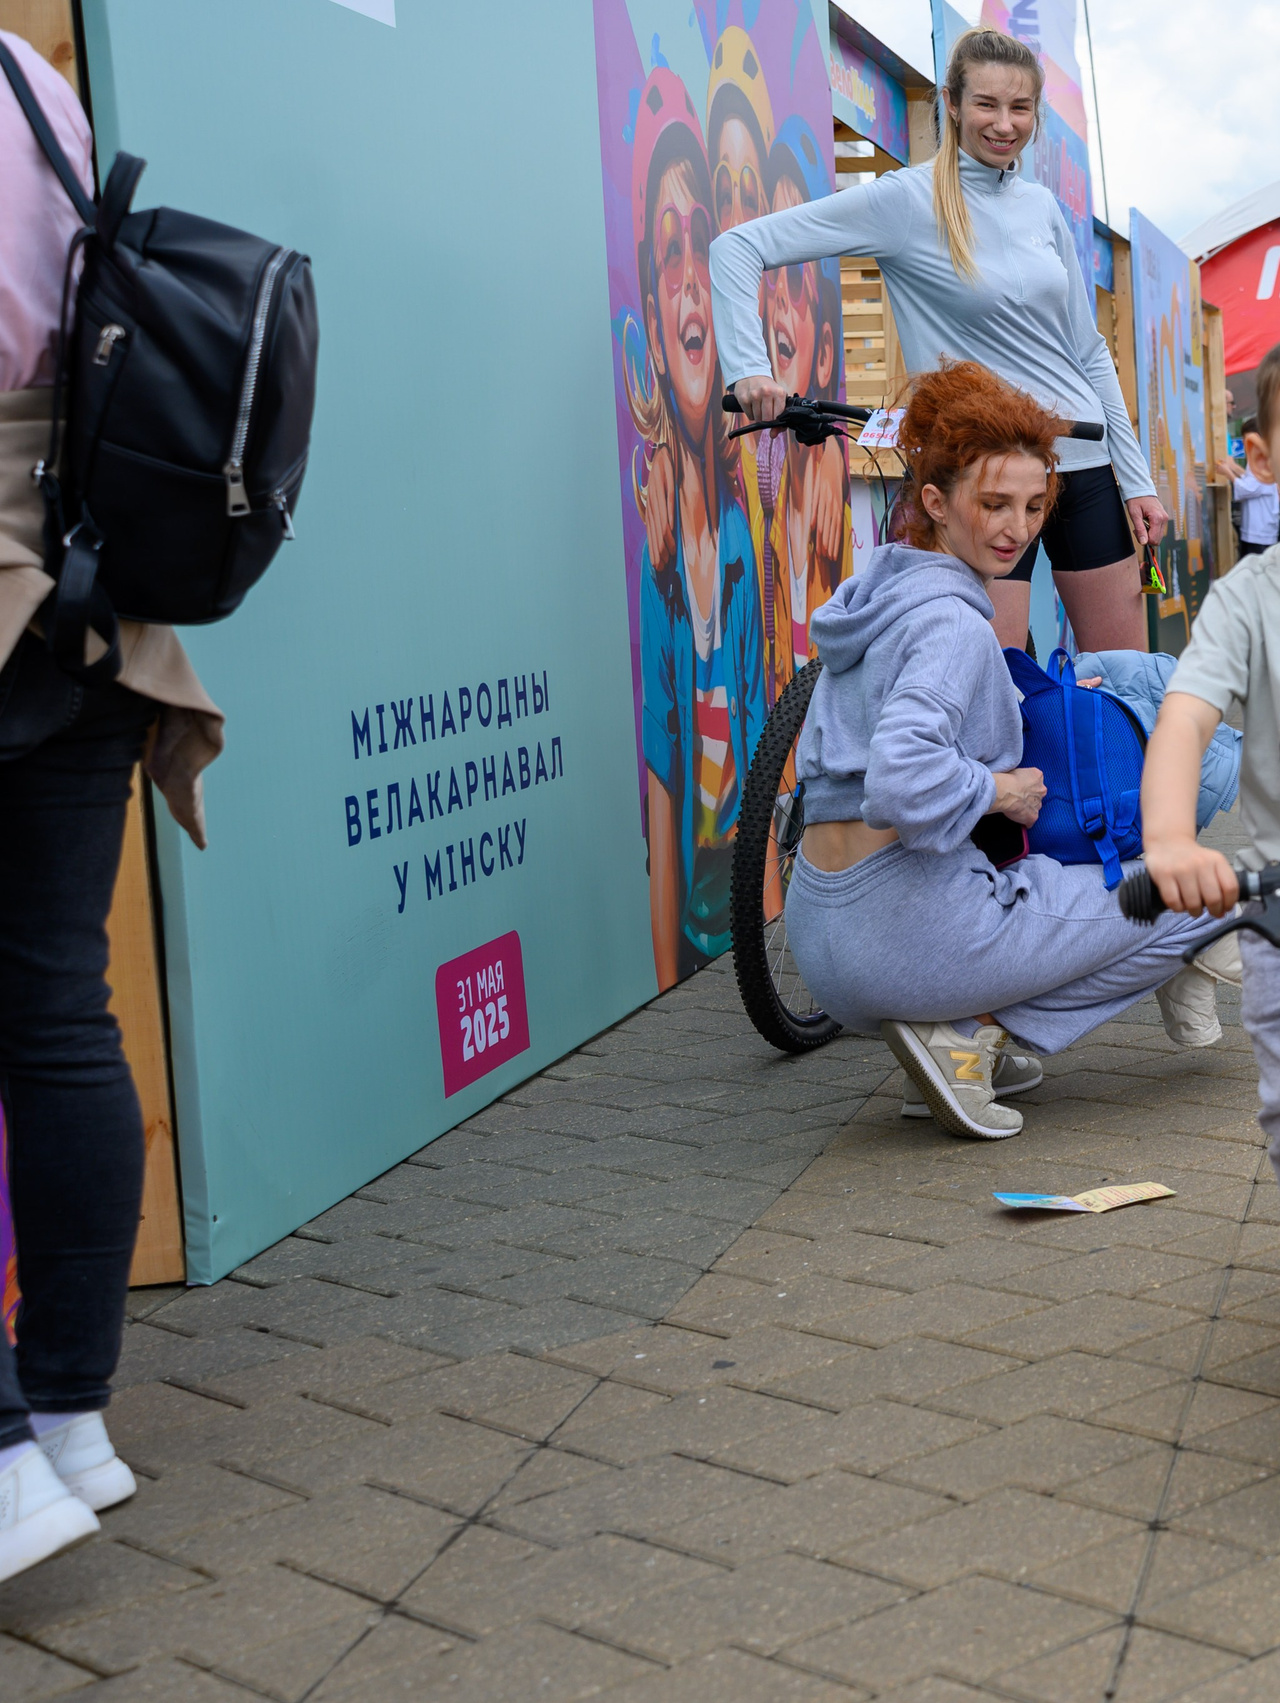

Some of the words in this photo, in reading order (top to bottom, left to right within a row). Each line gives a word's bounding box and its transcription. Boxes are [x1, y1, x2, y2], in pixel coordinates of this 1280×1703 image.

[351, 670, 549, 760] МІЖНАРОДНЫ
[344, 736, 563, 847] ВЕЛАКАРНАВАЛ
[393, 861, 409, 913] У
[424, 818, 528, 901] МІНСКУ
[456, 976, 473, 1013] 31
[476, 960, 504, 1004] МАЯ
[460, 994, 510, 1063] 2025
